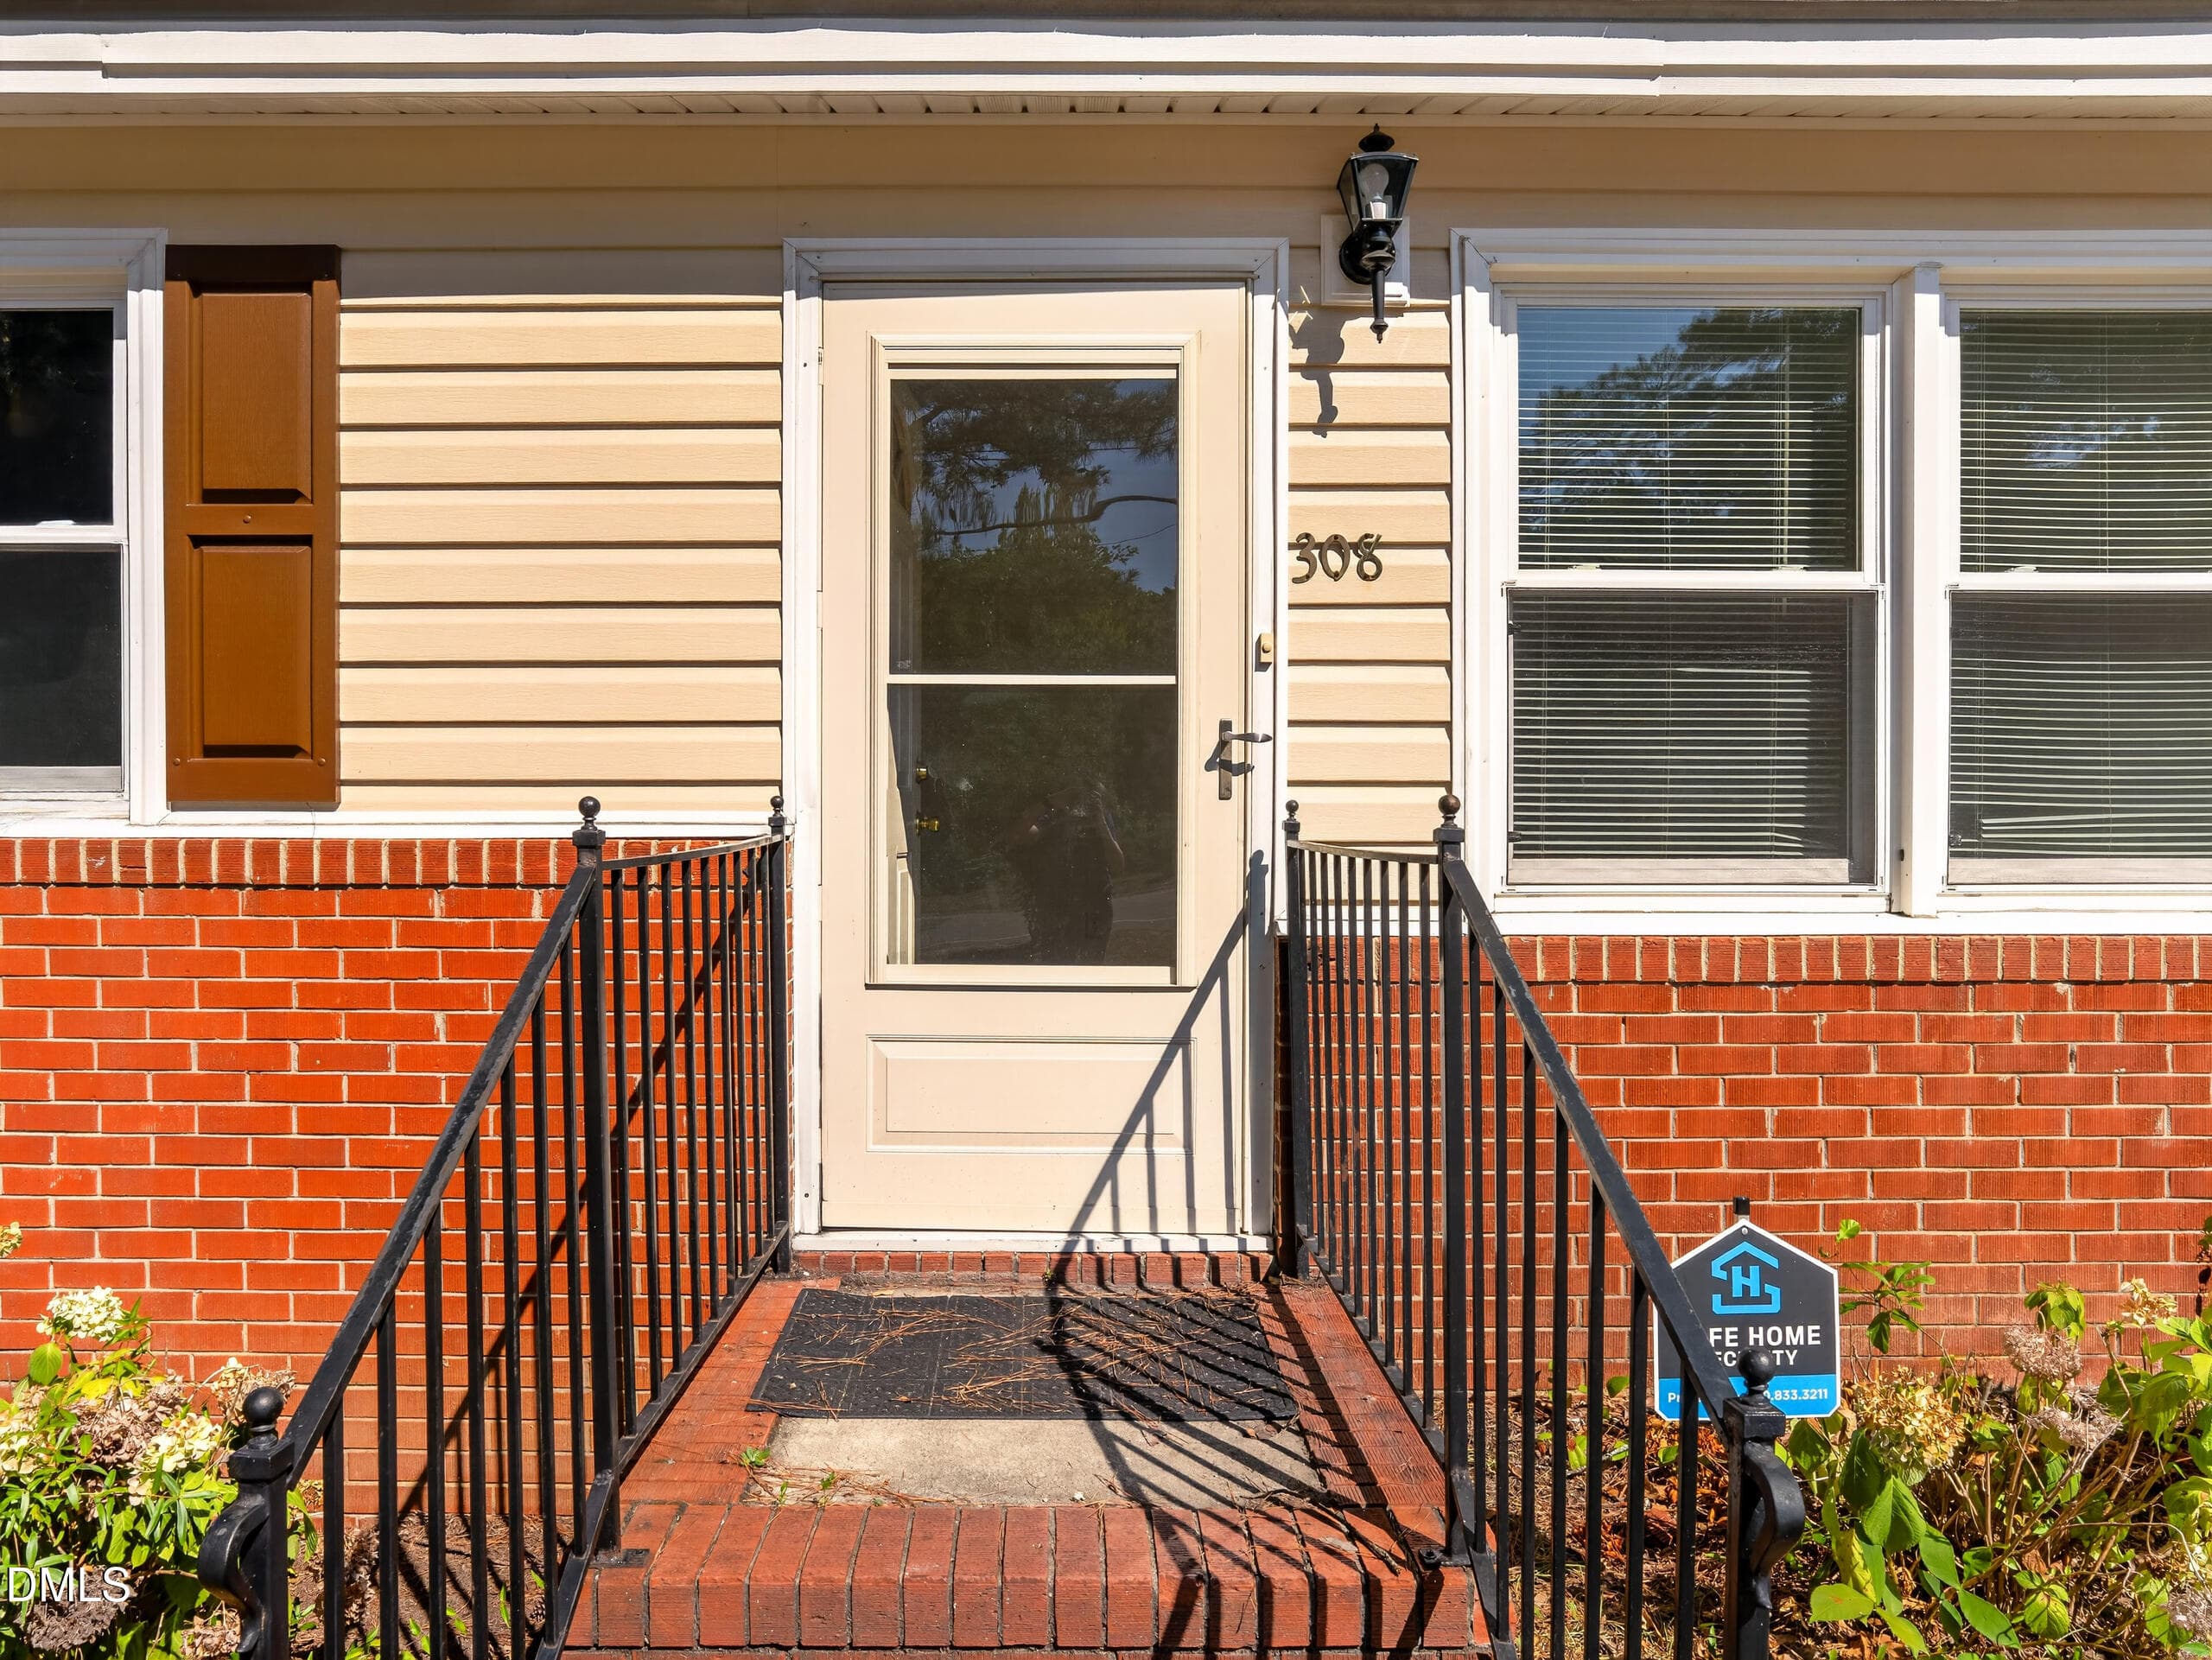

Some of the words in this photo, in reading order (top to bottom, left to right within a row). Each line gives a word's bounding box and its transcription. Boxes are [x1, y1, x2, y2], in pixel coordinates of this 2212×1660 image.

[1292, 532, 1382, 584] 308
[1709, 1326, 1739, 1347] FE
[1748, 1325, 1821, 1346] HOME
